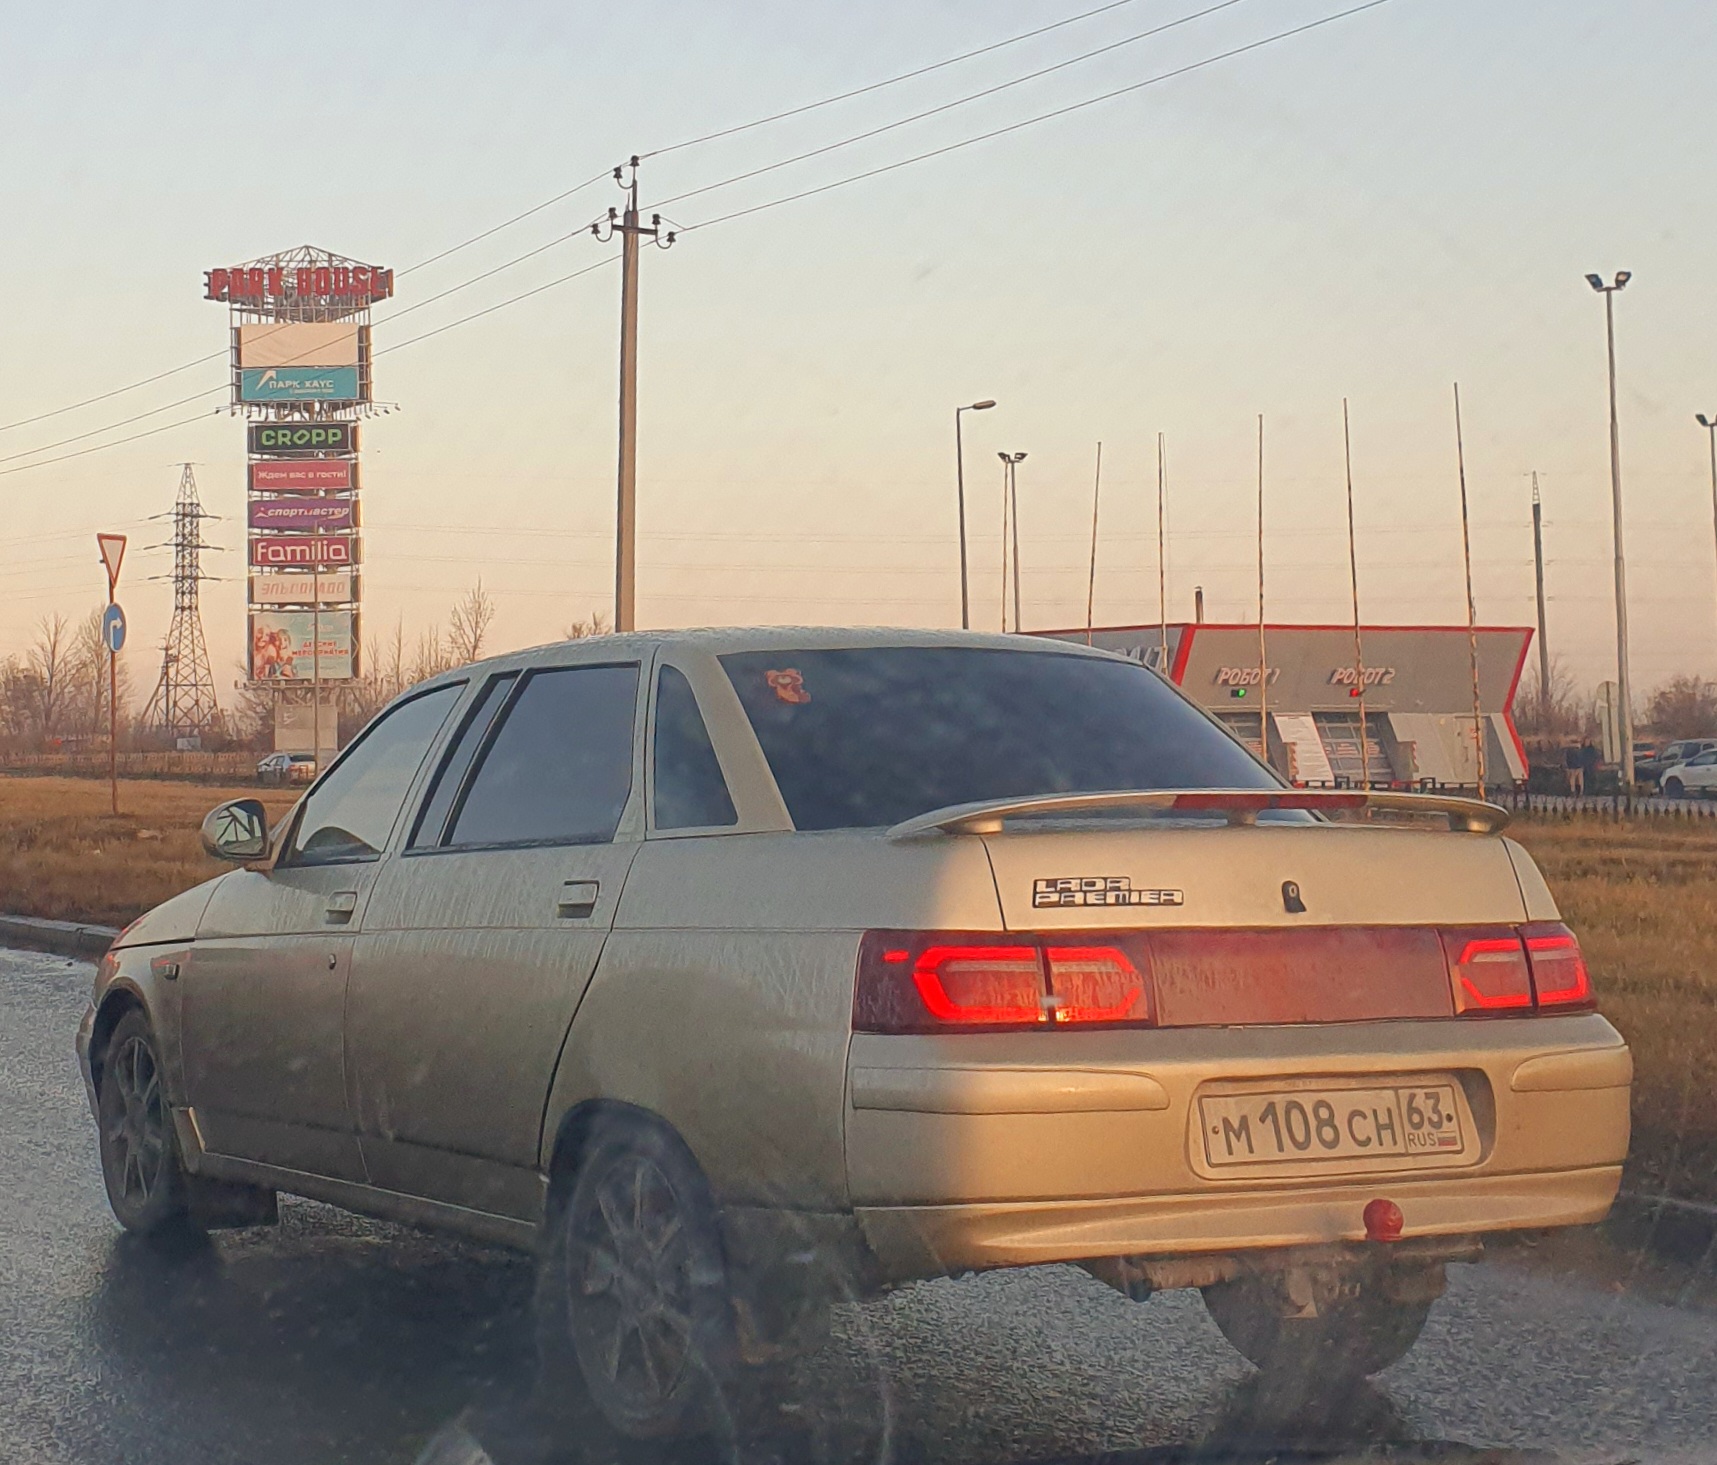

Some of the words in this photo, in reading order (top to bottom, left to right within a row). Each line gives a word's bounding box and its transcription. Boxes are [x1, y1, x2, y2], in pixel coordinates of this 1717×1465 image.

[209, 267, 284, 298] PARK
[297, 266, 386, 297] HOUSE
[269, 380, 300, 389] ПАРК
[304, 379, 334, 388] ХАУС
[261, 428, 342, 446] CROPP
[258, 470, 287, 479] Ждем
[316, 469, 347, 478] гости!
[267, 507, 350, 519] спортмастер
[256, 539, 348, 562] Familia
[1381, 667, 1396, 684] 2
[1035, 877, 1130, 892] LADA
[1034, 890, 1182, 906] PREMIER
[1406, 1091, 1443, 1131] 63
[1408, 1131, 1438, 1148] RUS
